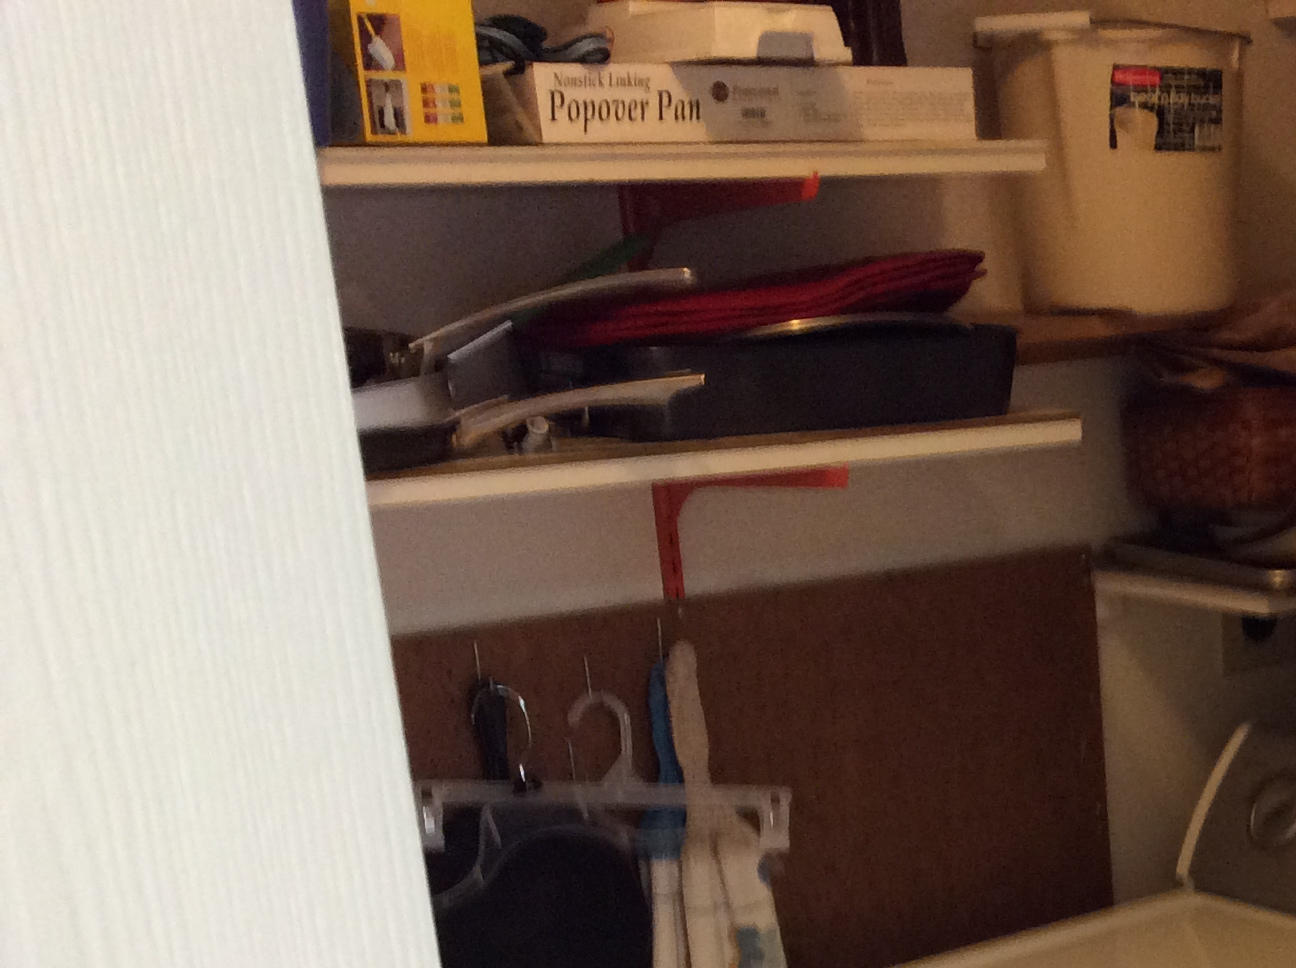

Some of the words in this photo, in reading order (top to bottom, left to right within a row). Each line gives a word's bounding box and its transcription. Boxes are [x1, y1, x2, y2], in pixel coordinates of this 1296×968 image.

[553, 71, 605, 88] Nonstick
[608, 71, 651, 92] Linking
[549, 89, 650, 134] Popover
[657, 89, 702, 122] Pan
